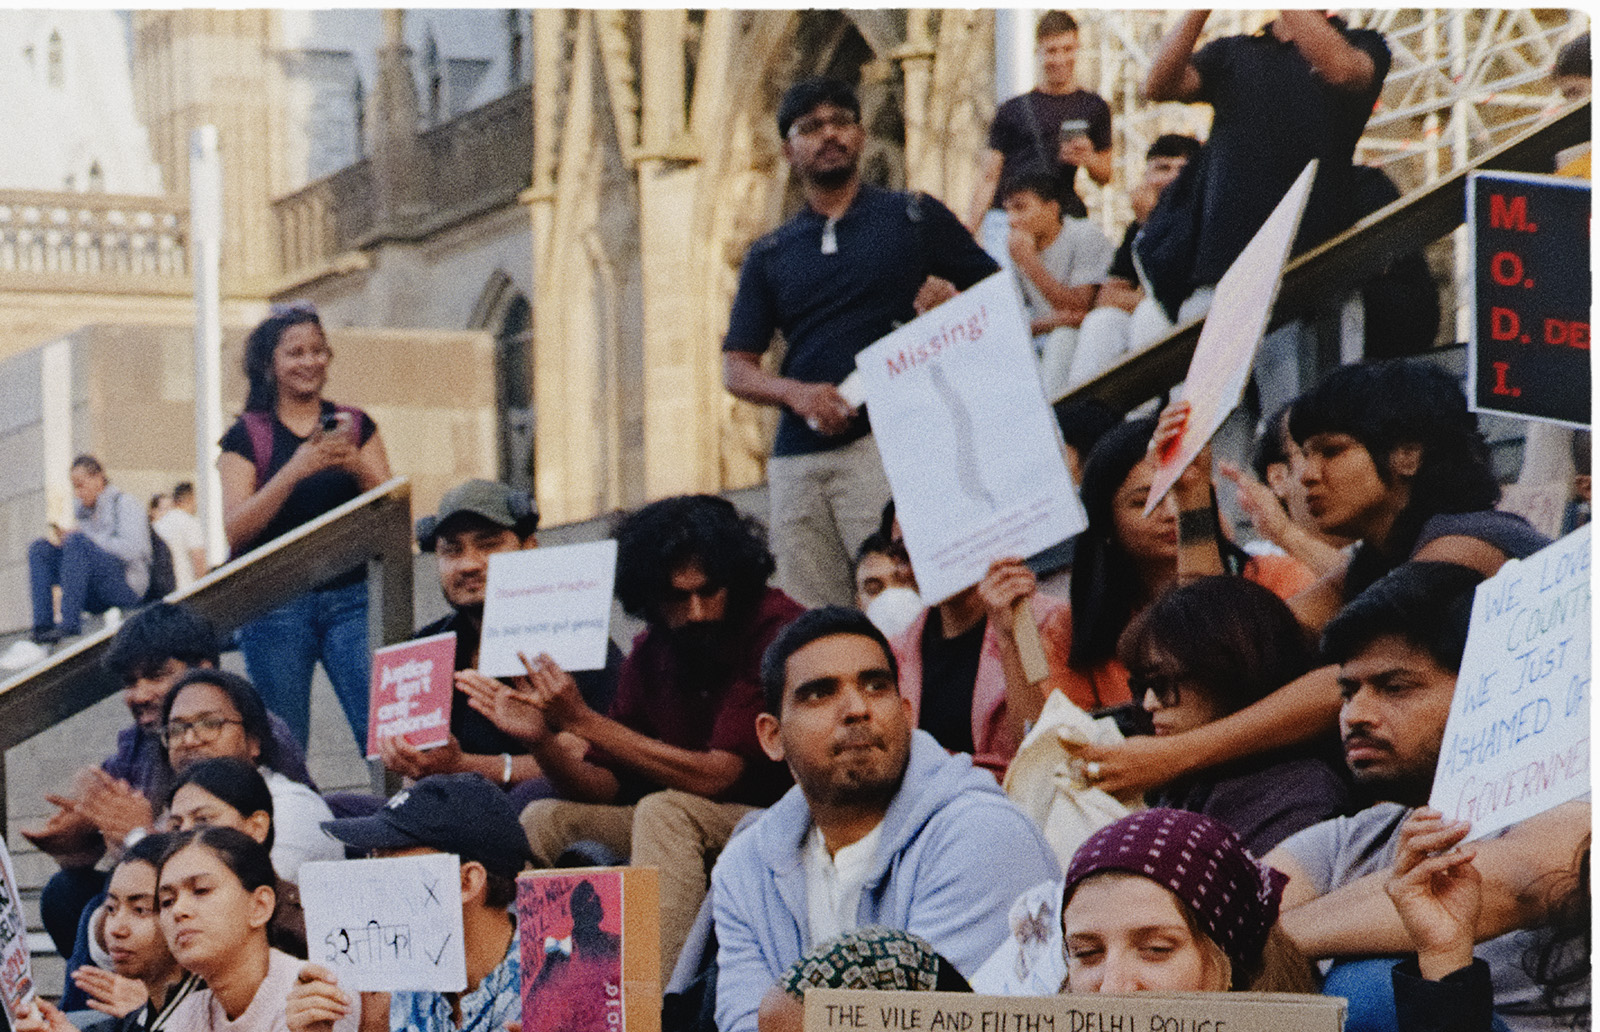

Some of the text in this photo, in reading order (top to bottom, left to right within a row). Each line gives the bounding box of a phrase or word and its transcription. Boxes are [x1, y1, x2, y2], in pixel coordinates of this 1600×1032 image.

[1490, 194, 1537, 232] M.
[1490, 252, 1535, 288] O.
[886, 305, 988, 378] Missing!
[1491, 306, 1531, 344] D.
[1492, 361, 1521, 397] I.
[827, 1005, 868, 1028] THE
[881, 1008, 922, 1031] VILE
[930, 1010, 973, 1032] AND
